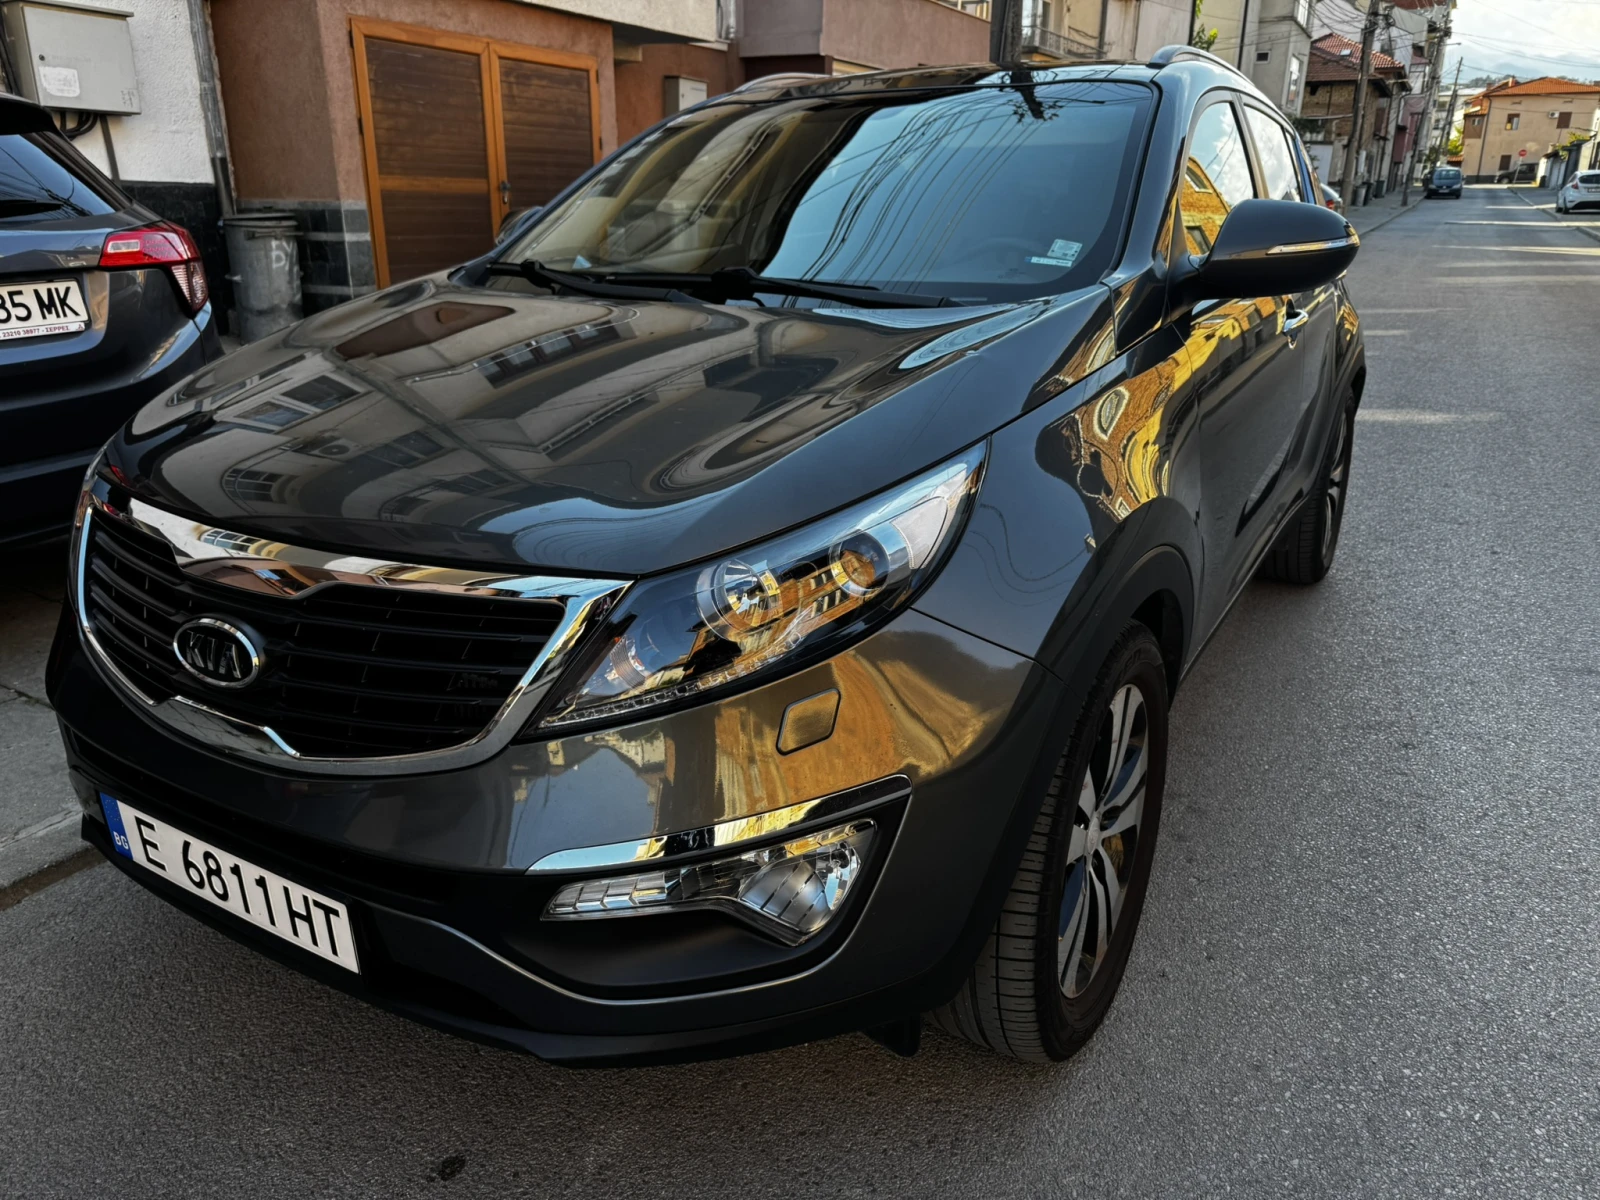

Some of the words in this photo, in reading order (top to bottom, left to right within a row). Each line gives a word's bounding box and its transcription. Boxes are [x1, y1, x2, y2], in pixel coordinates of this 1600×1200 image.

[33, 286, 81, 320] MK
[2, 330, 21, 338] 23210
[186, 630, 242, 679] KIA
[113, 830, 129, 850] BG
[134, 815, 167, 872] E
